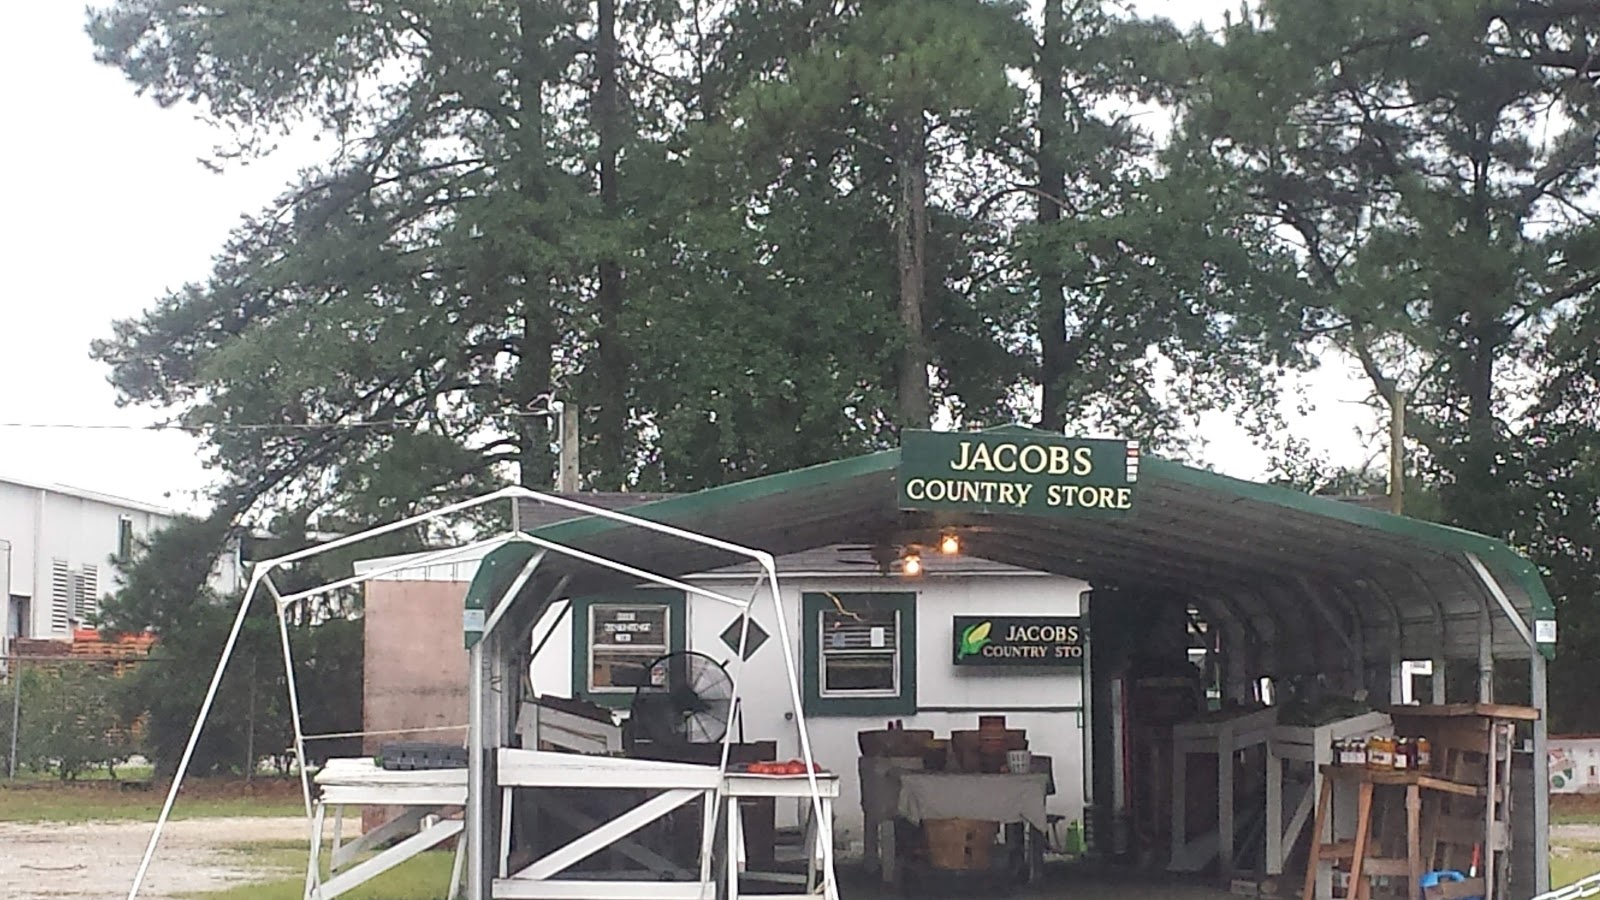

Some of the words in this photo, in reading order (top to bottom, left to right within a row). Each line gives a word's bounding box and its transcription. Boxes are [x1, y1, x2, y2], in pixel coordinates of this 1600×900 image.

[950, 441, 1093, 476] JACOBS
[906, 478, 1033, 506] COUNTRY
[1046, 483, 1132, 509] STORE
[1005, 625, 1079, 642] JACOBS
[982, 645, 1048, 658] COUNTRY
[1054, 646, 1083, 658] STO
